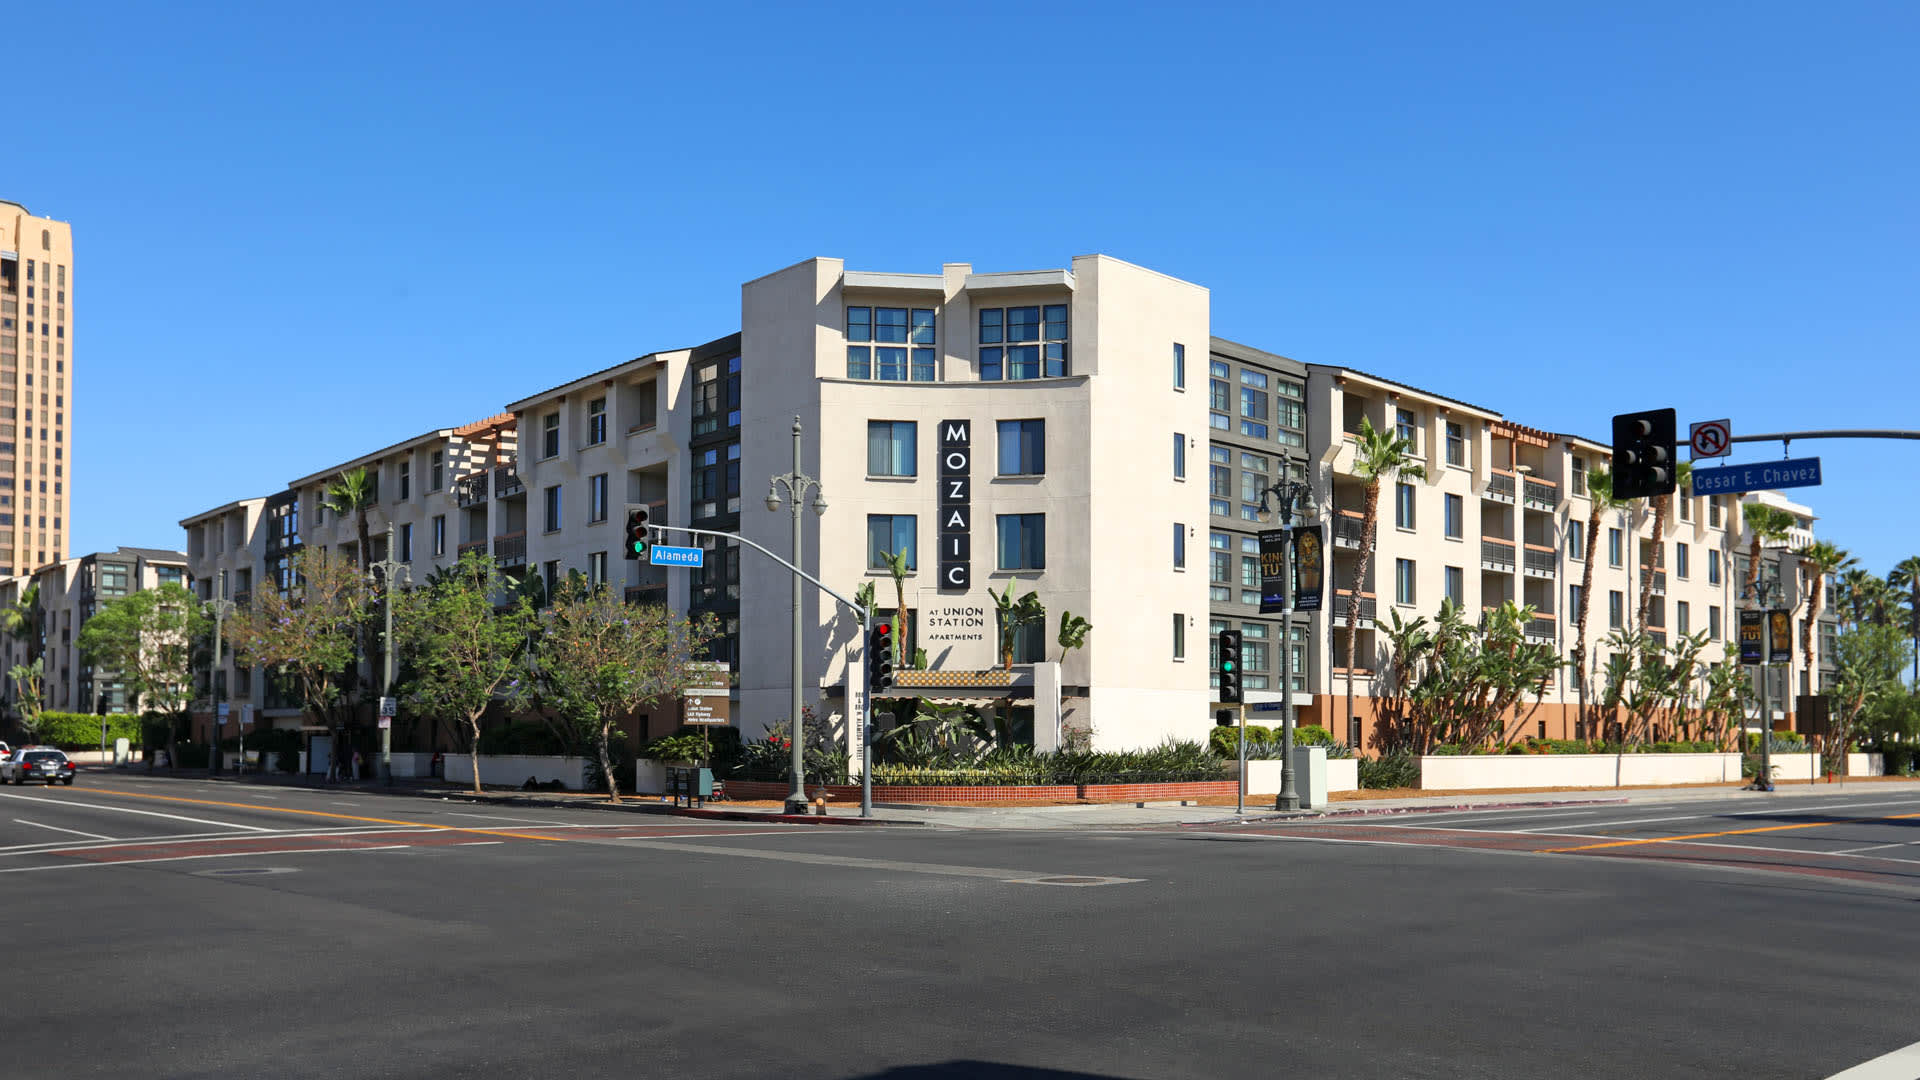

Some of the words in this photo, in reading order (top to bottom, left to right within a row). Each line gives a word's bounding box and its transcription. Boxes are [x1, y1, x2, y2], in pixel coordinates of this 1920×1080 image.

[1696, 475, 1737, 490] Cesar
[1744, 471, 1758, 485] E.
[1763, 467, 1817, 484] Chavez
[945, 423, 967, 585] MOZAIC
[655, 549, 699, 562] Alameda
[943, 607, 984, 616] UNION
[929, 618, 984, 627] STATION
[383, 706, 394, 715] 35
